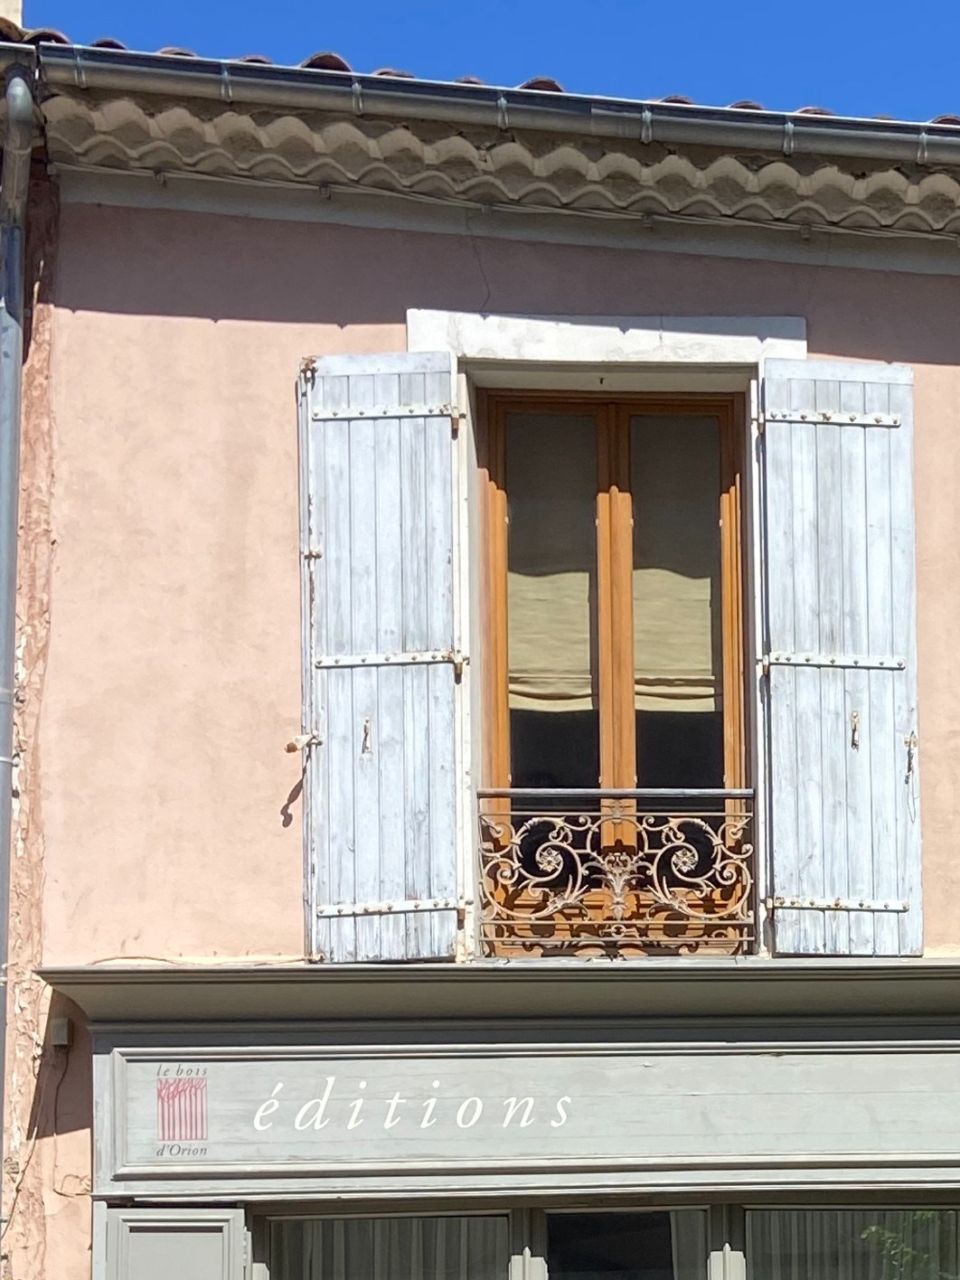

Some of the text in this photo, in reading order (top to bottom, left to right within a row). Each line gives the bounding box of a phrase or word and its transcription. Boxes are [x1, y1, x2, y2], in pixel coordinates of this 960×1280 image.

[156, 1063, 208, 1077] le bois
[253, 1076, 572, 1131] éditions
[156, 1143, 208, 1157] d'Orion
